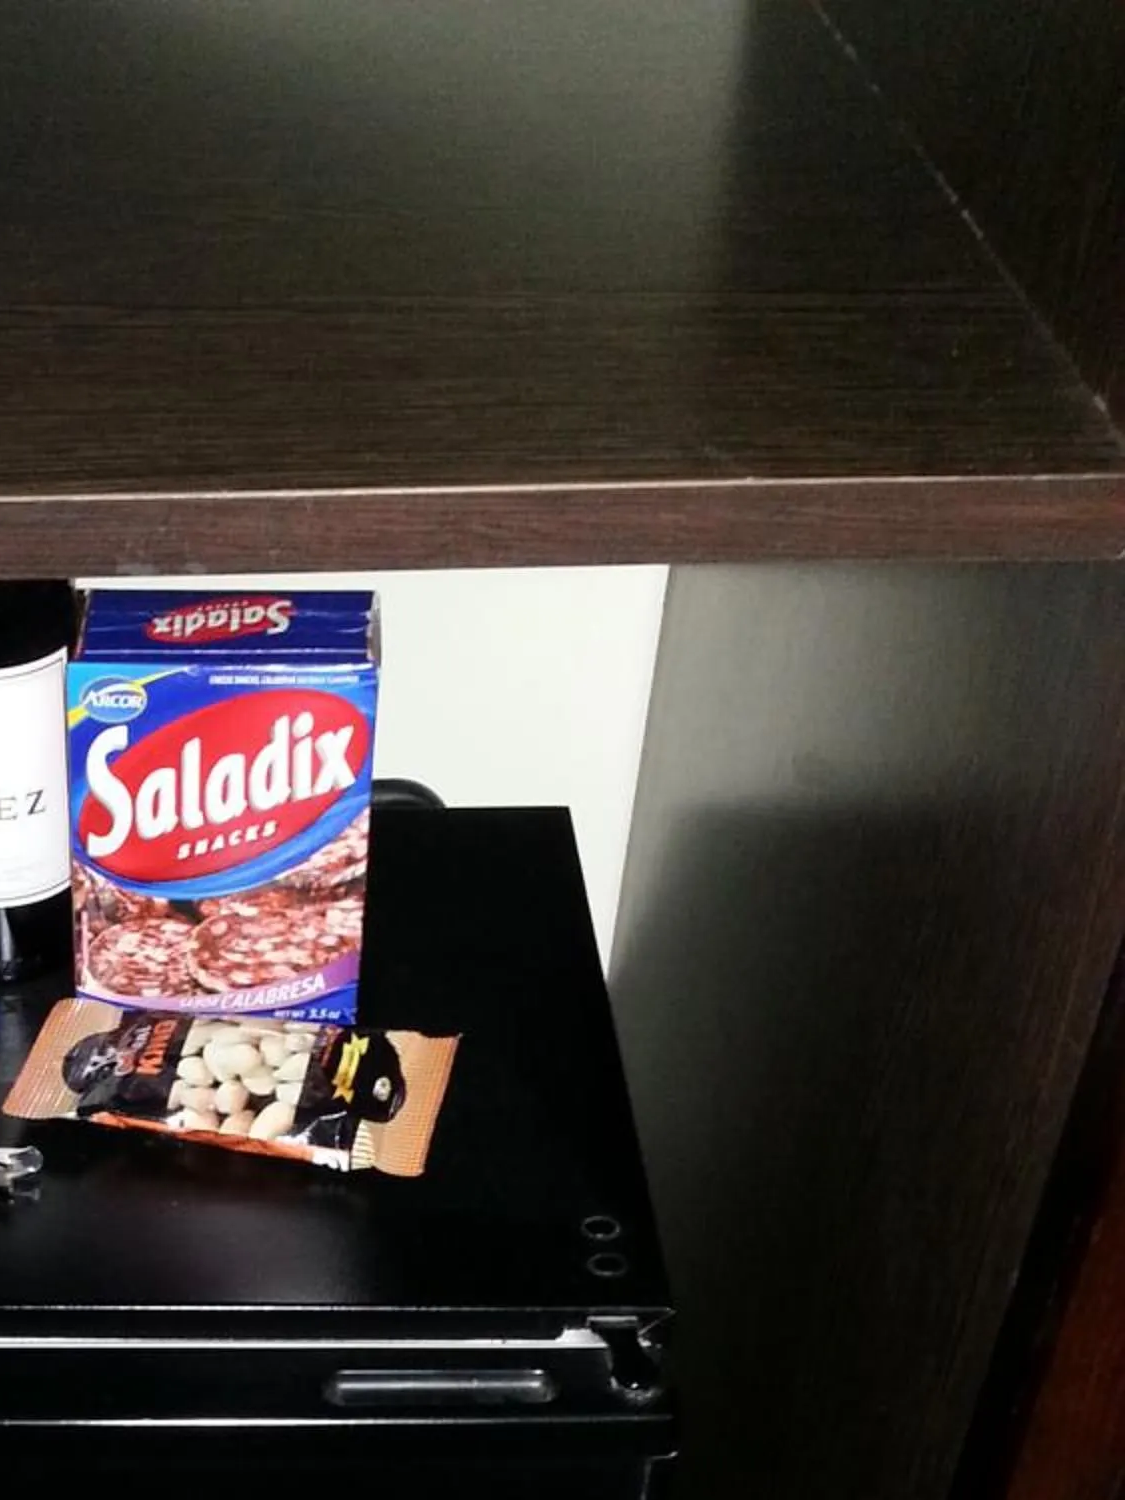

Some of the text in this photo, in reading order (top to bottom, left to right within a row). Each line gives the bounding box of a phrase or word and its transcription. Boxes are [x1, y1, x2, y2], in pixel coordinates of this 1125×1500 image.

[152, 600, 291, 638] Saladix
[85, 711, 356, 858] Saladix
[177, 819, 278, 860] SNACKS
[220, 973, 326, 1009] CALABRESA
